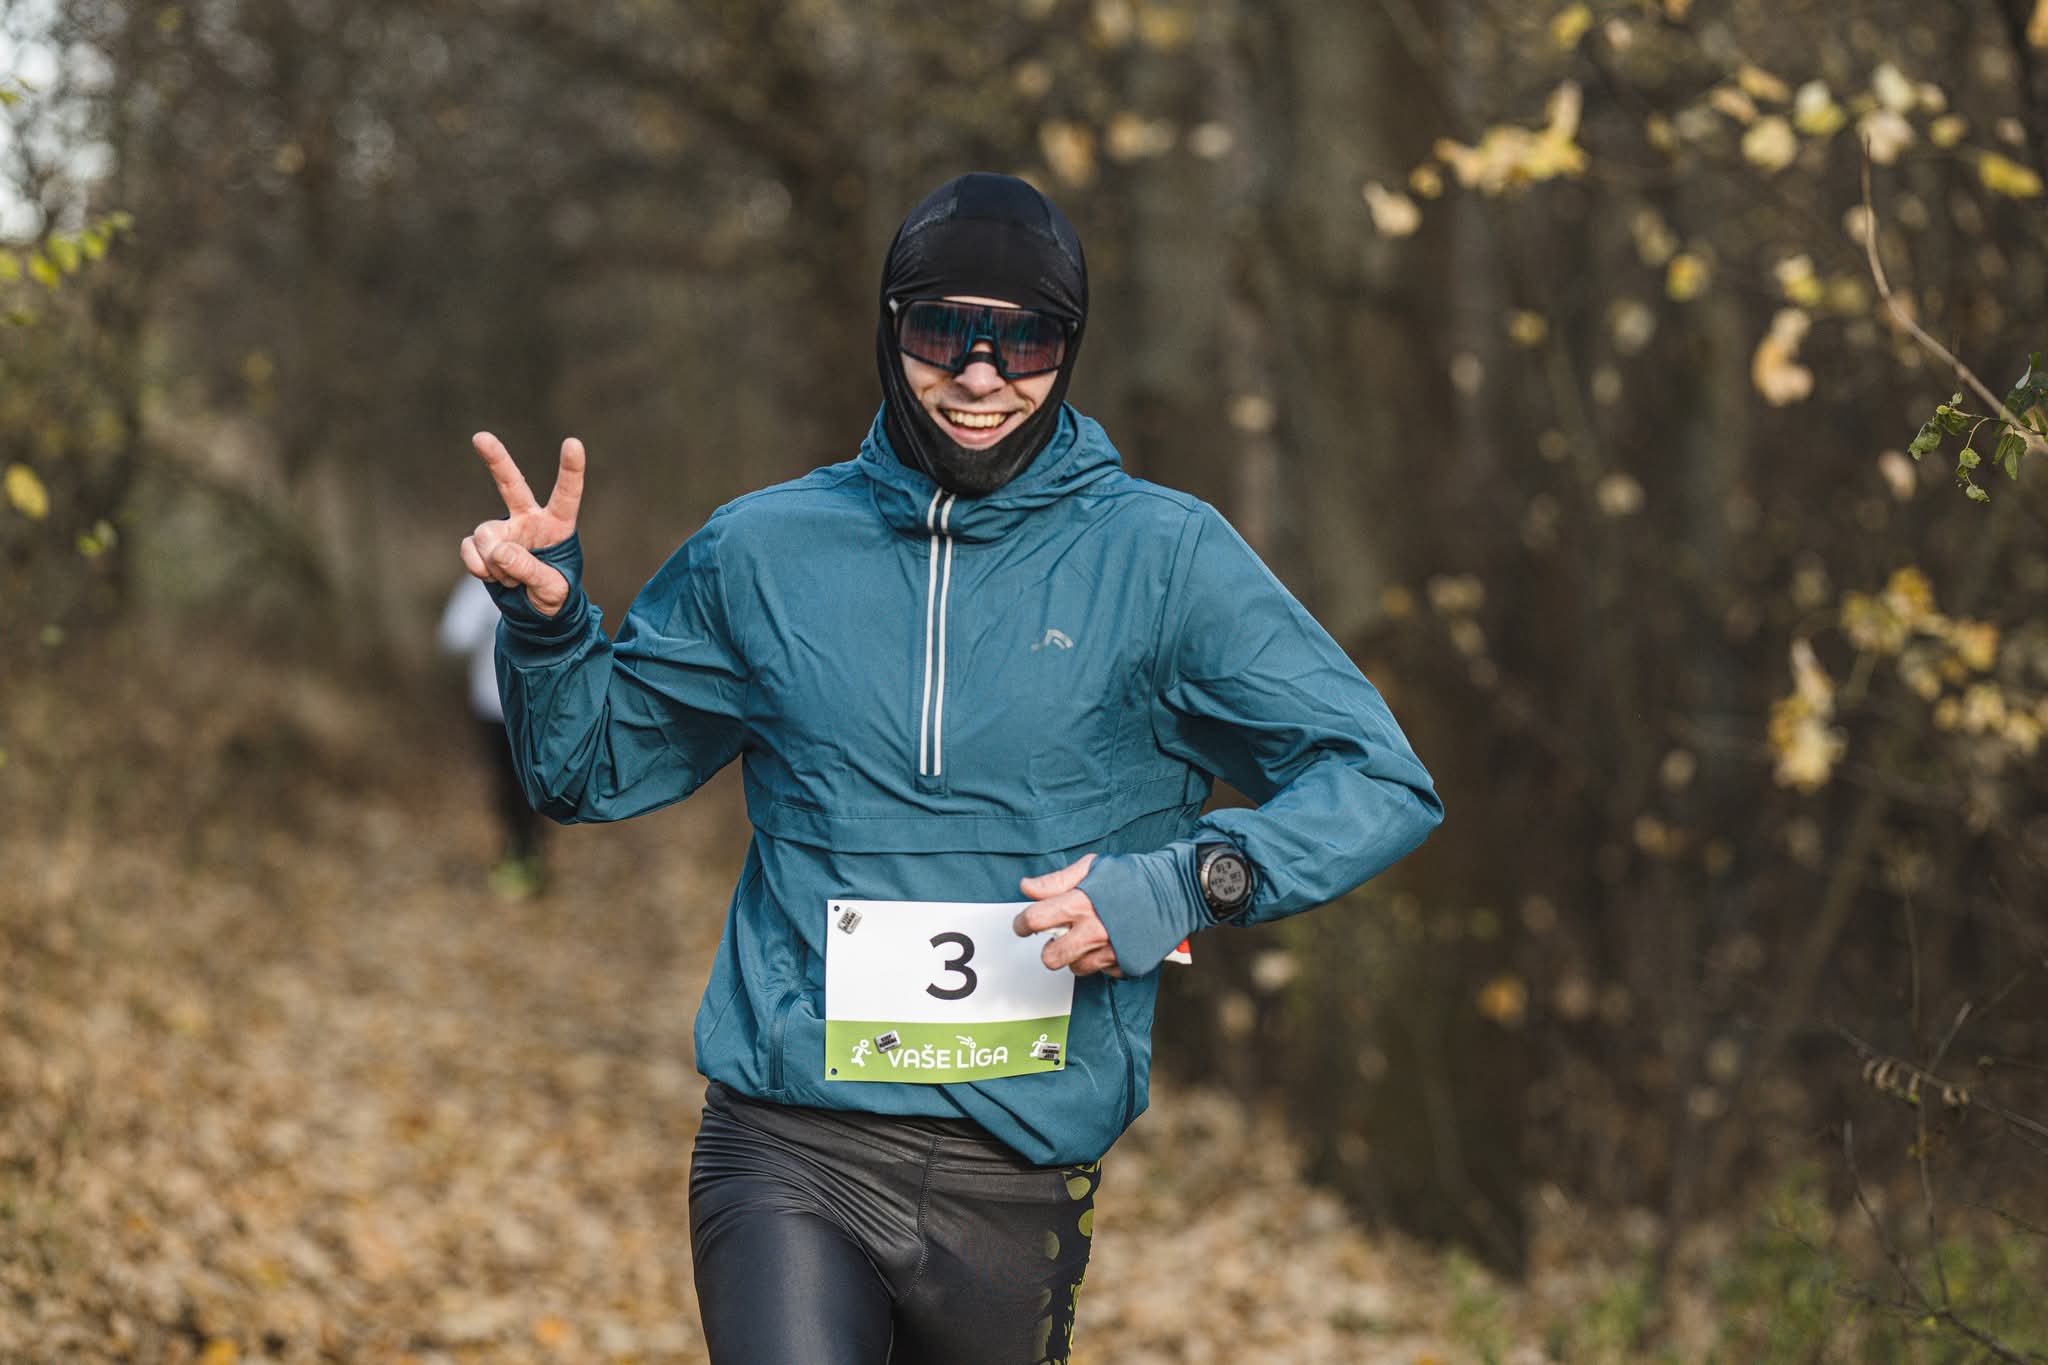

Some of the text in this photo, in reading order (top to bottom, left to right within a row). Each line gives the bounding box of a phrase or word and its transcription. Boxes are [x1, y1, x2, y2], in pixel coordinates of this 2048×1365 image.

[926, 932, 977, 1000] 3
[887, 1043, 1008, 1068] VAŠE LIGA
